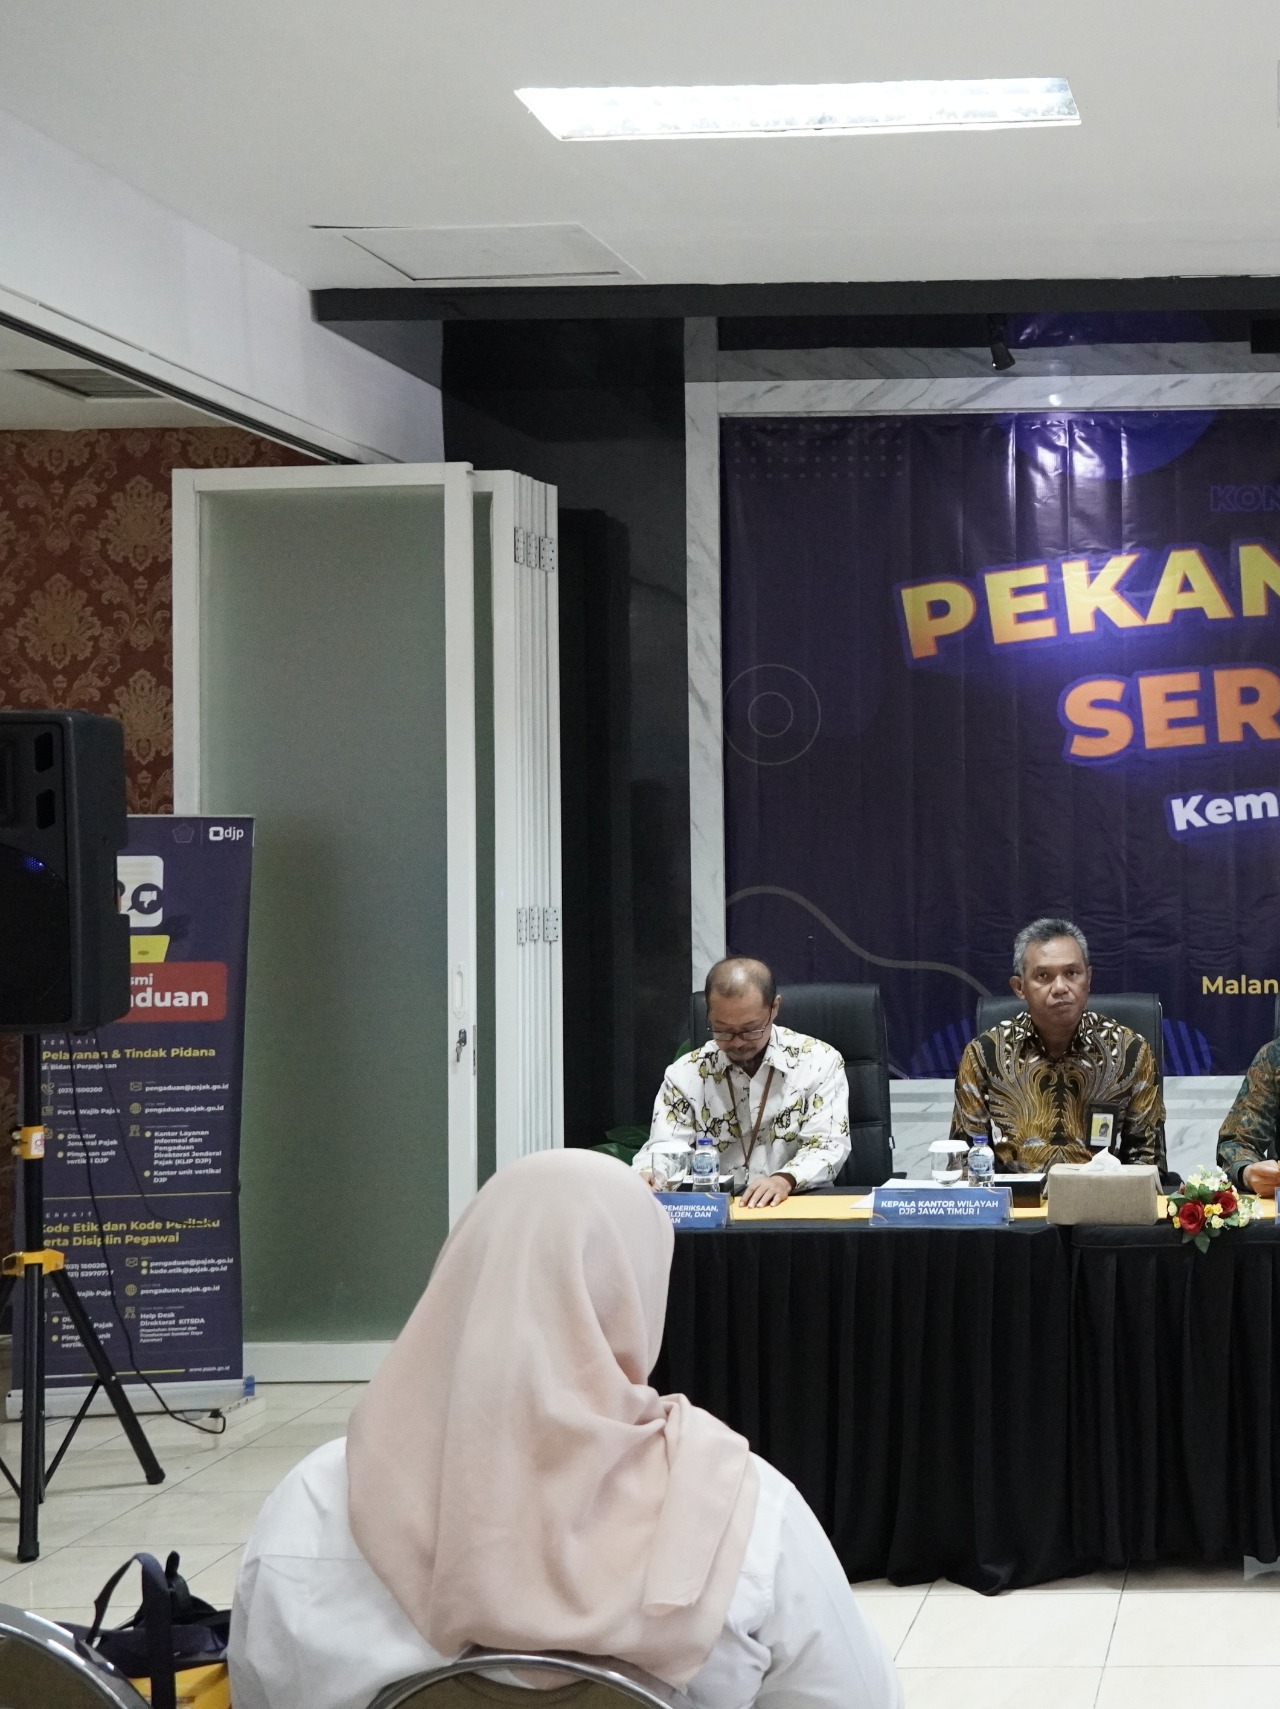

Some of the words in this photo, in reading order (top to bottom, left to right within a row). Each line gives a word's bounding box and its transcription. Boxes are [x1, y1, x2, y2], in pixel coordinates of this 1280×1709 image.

[224, 826, 244, 841] djp
[130, 973, 153, 986] smi
[130, 987, 209, 1008] duan
[112, 1049, 121, 1059] &
[124, 1048, 167, 1058] Tindak
[171, 1047, 216, 1057] Pidana
[145, 1083, 230, 1092] pengaduan@pajak.go.id
[145, 1105, 225, 1114] pengaduan.pajak.go.id
[663, 1204, 719, 1212] PEMERIKSAAN,
[881, 1200, 916, 1208] KEPALA
[918, 1200, 954, 1208] KANTOR
[957, 1200, 999, 1208] WILAYAH
[73, 1222, 99, 1232] Etik
[103, 1221, 127, 1231] dan
[131, 1220, 162, 1230] Kode
[43, 1238, 69, 1247] erta
[125, 1232, 180, 1246] Pegawai
[140, 1285, 220, 1295] pengaduan.pajak.go.id
